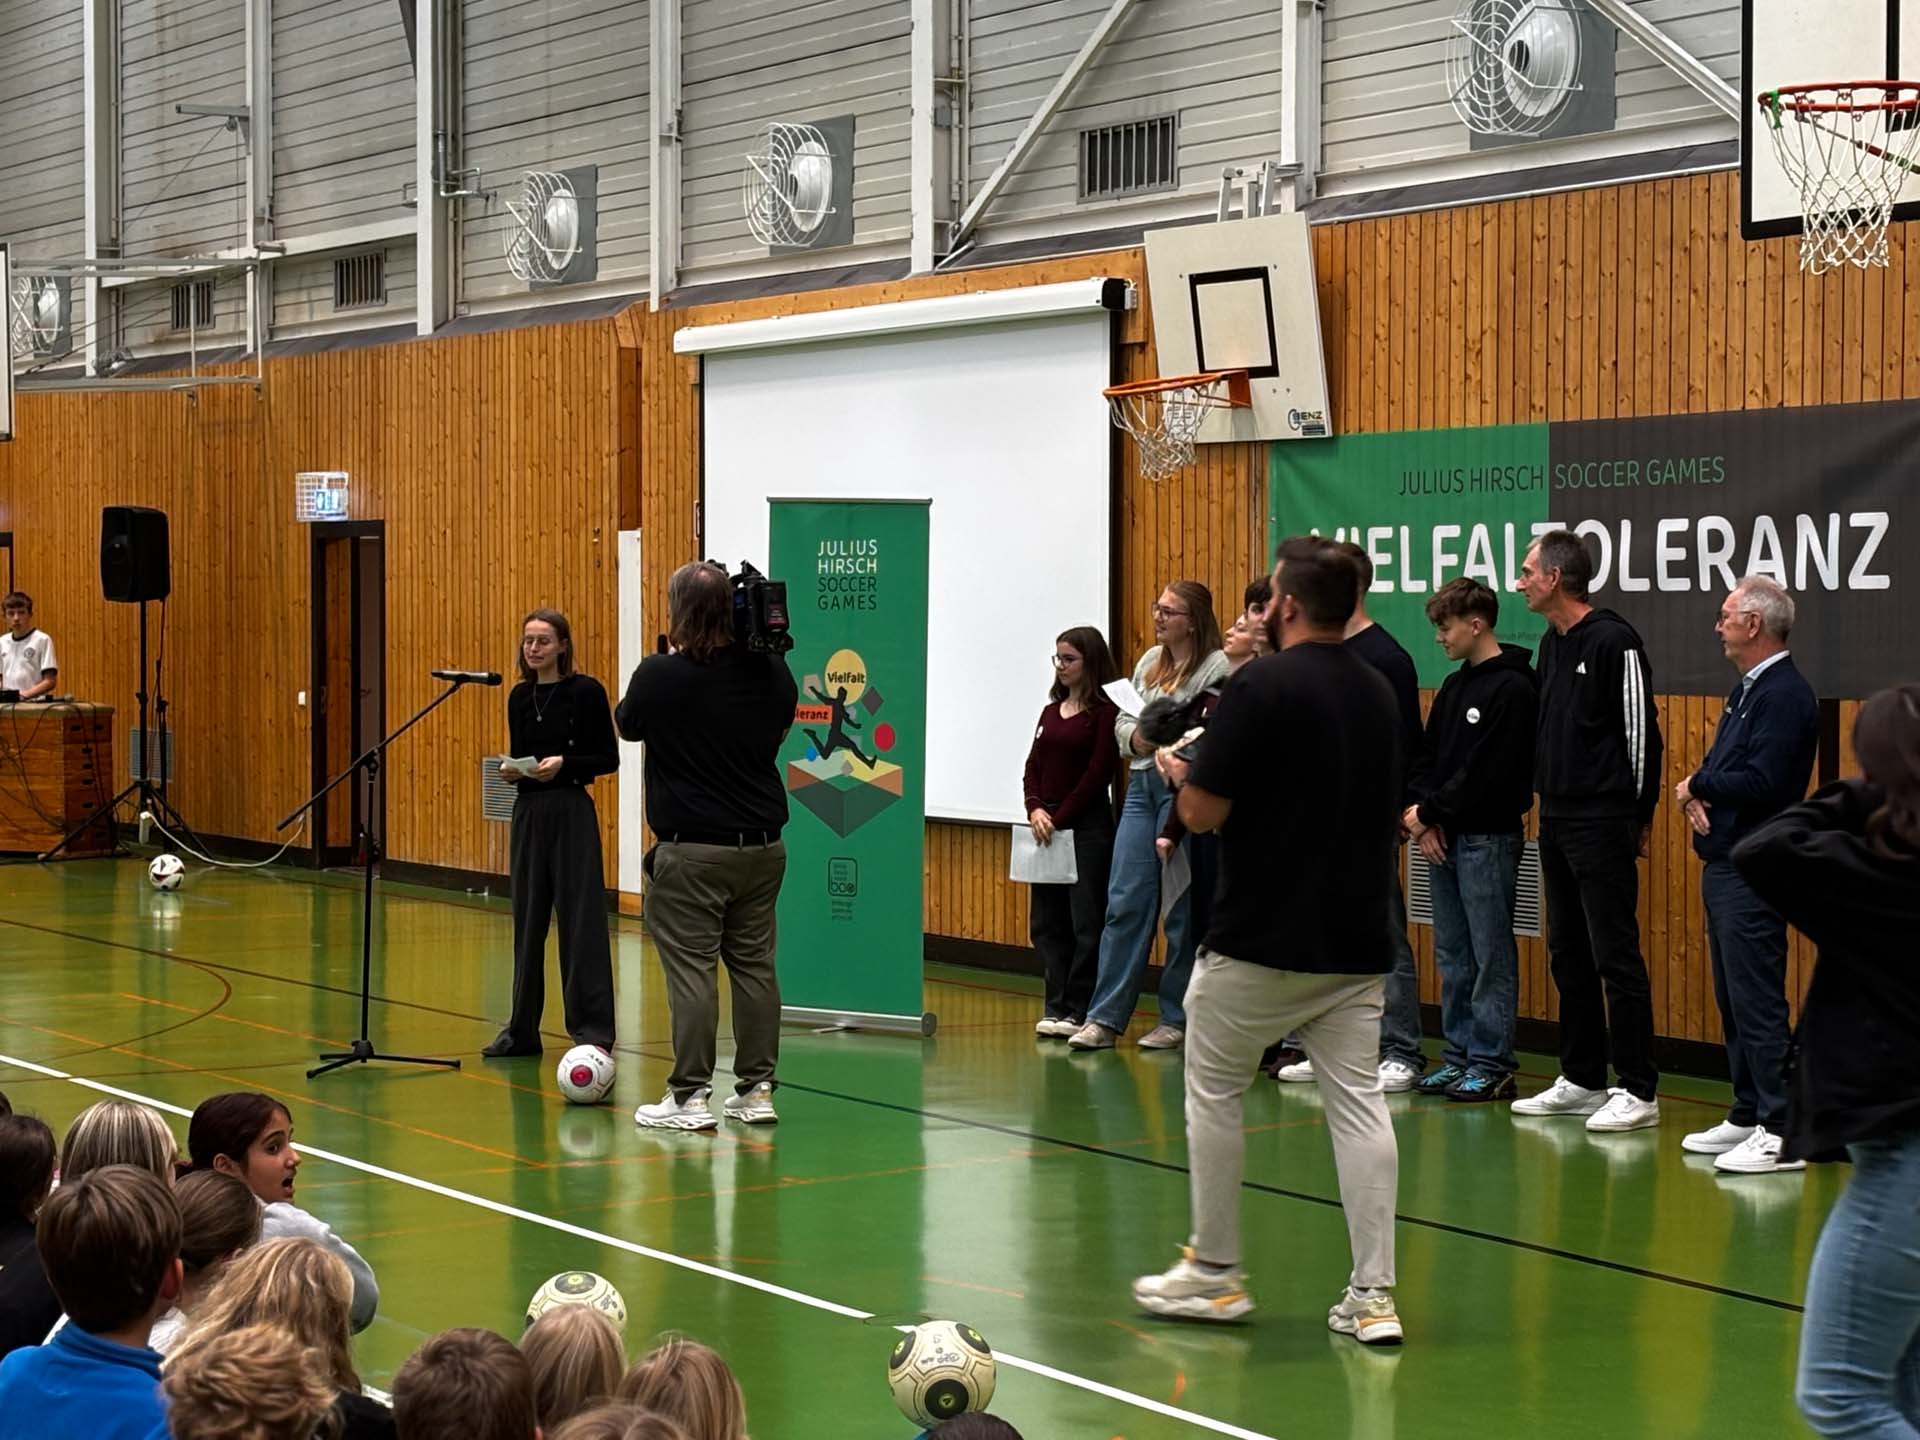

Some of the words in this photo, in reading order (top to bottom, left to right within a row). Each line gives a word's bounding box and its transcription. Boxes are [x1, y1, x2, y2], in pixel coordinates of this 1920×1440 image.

[1400, 468, 1464, 496] JULIUS
[1470, 465, 1544, 492] HIRSCH
[1555, 459, 1640, 489] SOCCER
[1647, 455, 1725, 485] GAMES
[817, 538, 878, 556] JULIUS
[817, 557, 878, 575] HIRSCH
[817, 576, 878, 593] SOCCER
[817, 594, 878, 611] GAMES
[827, 671, 866, 684] Vielfalt
[796, 707, 829, 720] leranz
